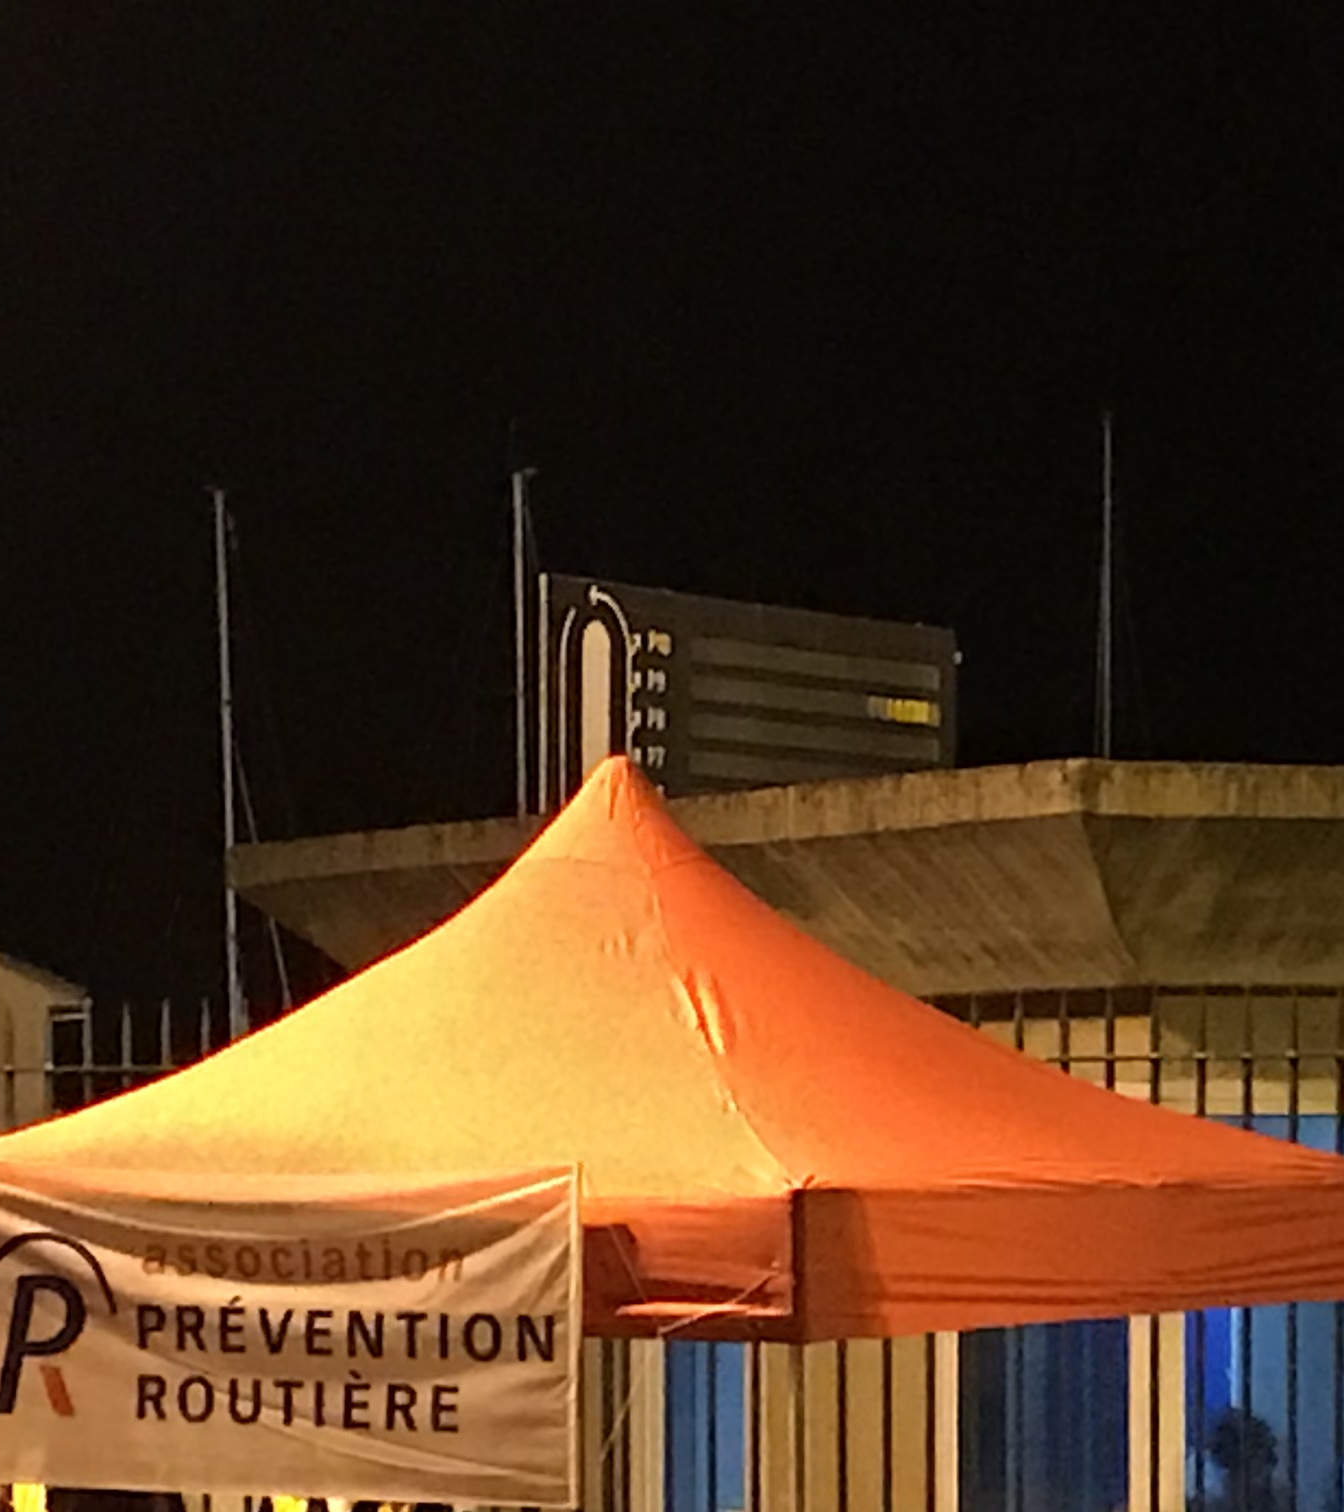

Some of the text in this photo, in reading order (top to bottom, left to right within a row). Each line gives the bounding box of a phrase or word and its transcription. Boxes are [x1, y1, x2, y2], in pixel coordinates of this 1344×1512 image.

[141, 1236, 464, 1284] association
[136, 1297, 557, 1363] PRÉVENTION
[136, 1370, 462, 1433] ROUTIÈRE
